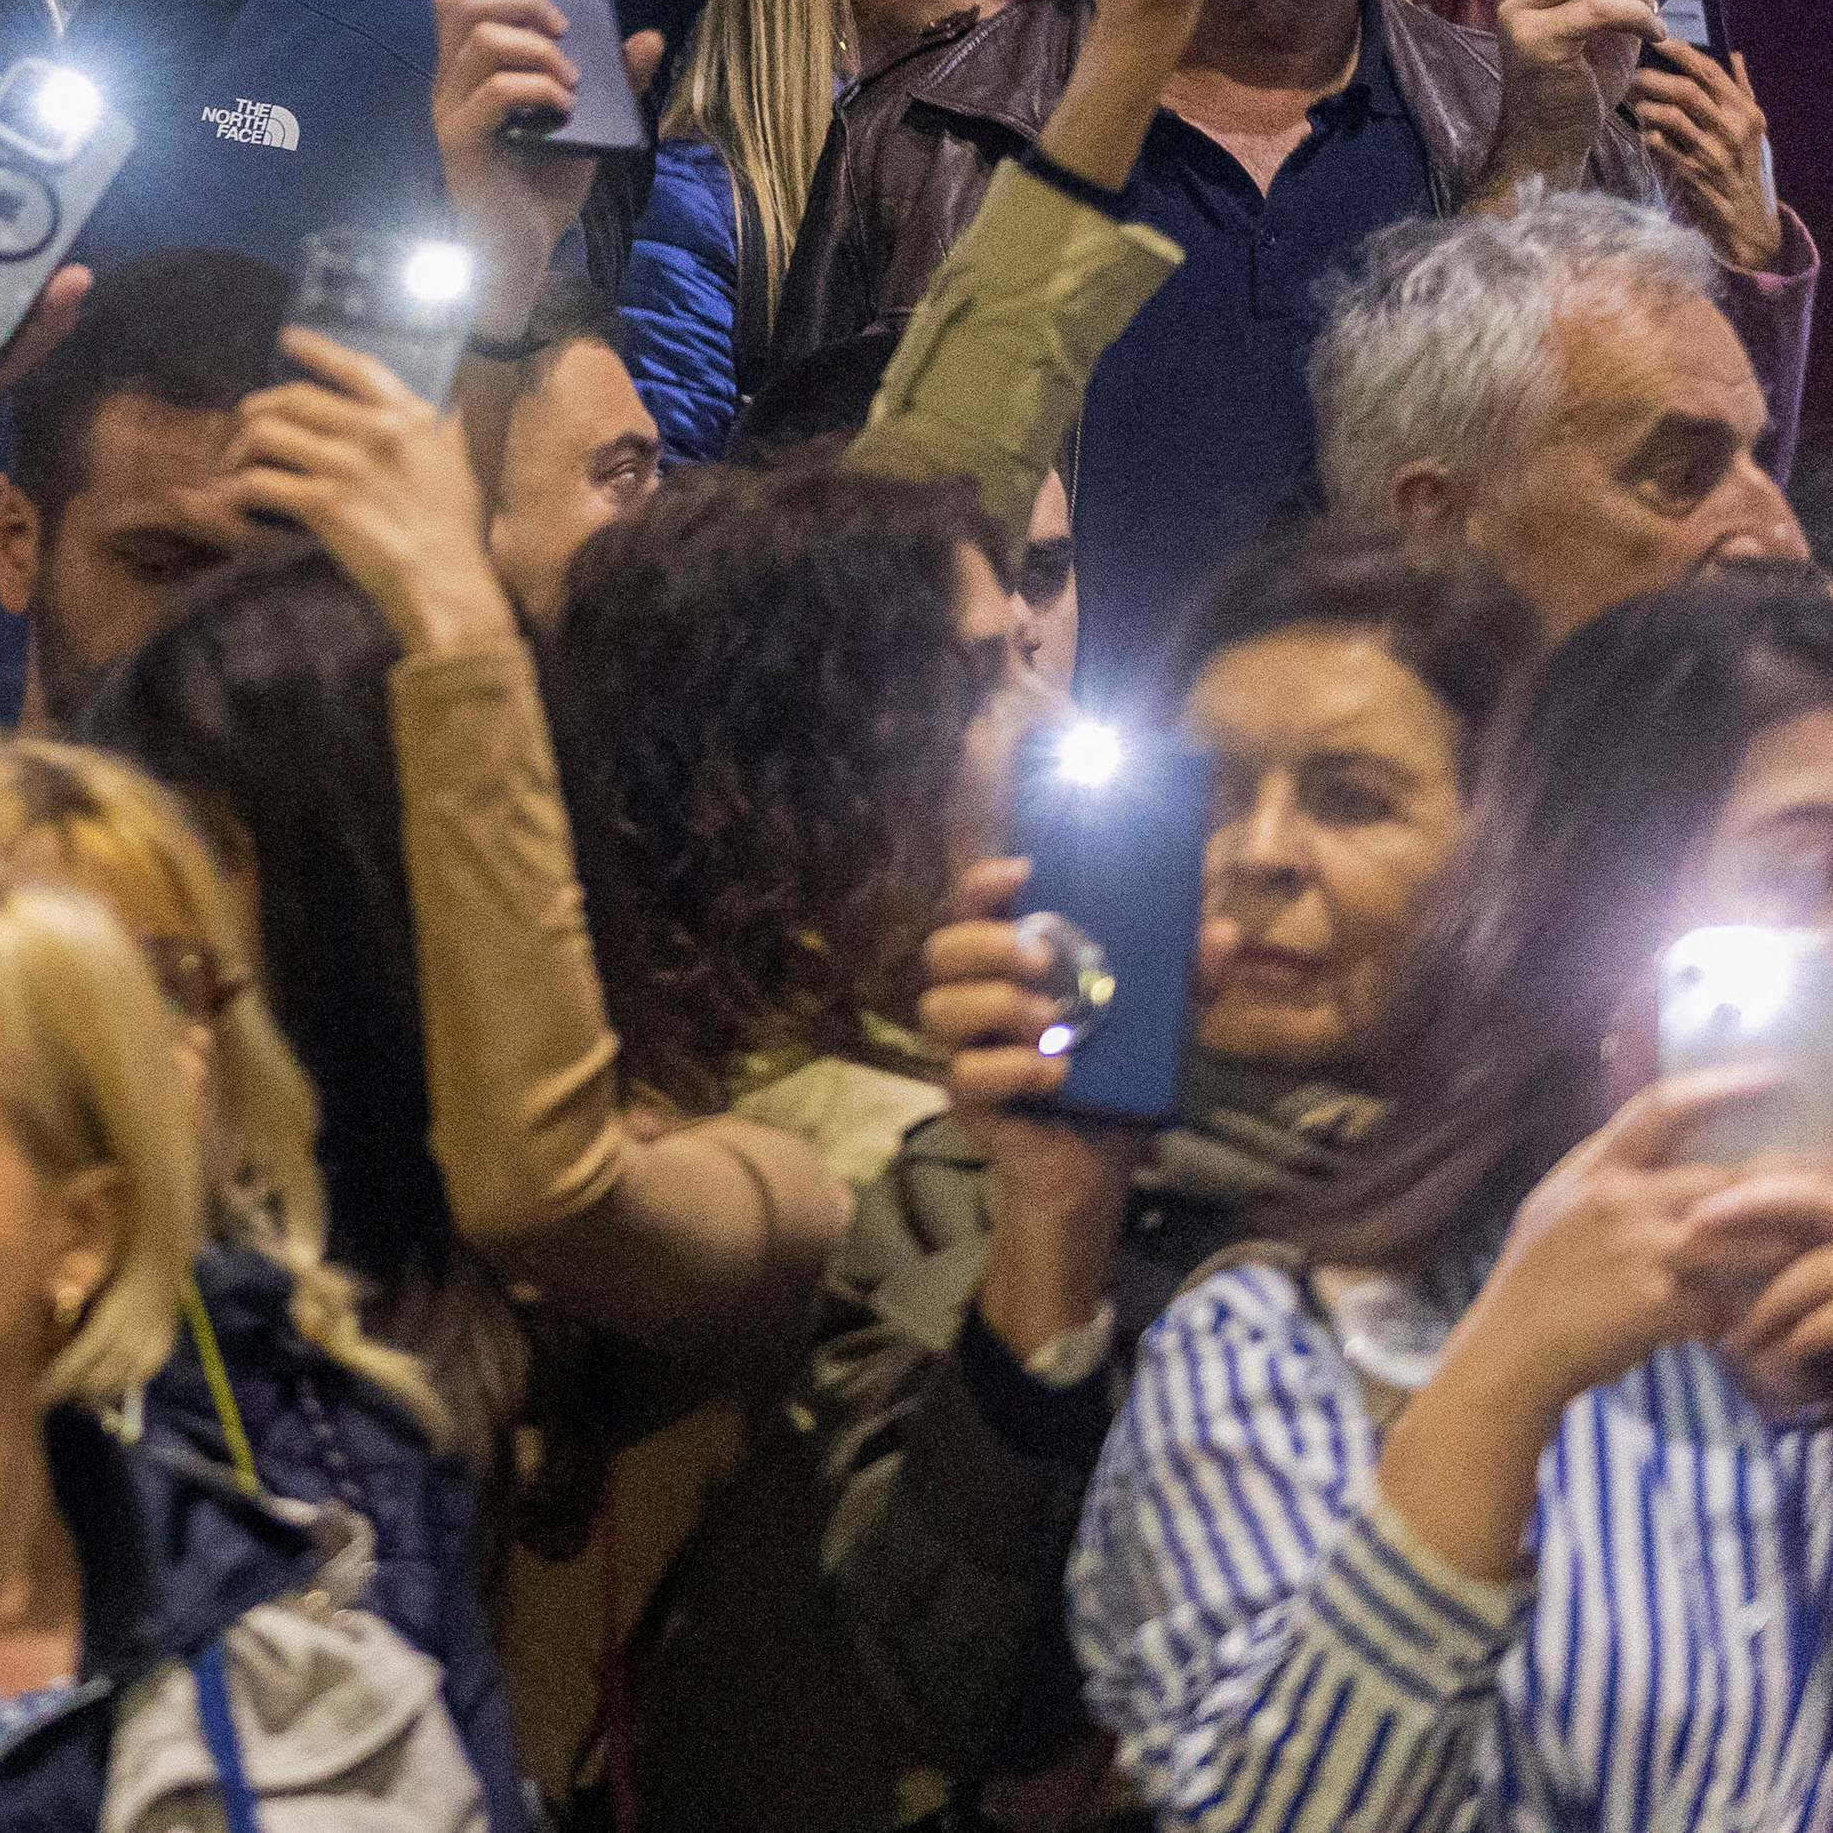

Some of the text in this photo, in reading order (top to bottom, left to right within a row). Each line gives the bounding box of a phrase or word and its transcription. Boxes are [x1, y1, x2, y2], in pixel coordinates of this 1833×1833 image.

[201, 106, 267, 131] NORTH
[236, 98, 271, 118] THE
[216, 124, 263, 145] FACE
